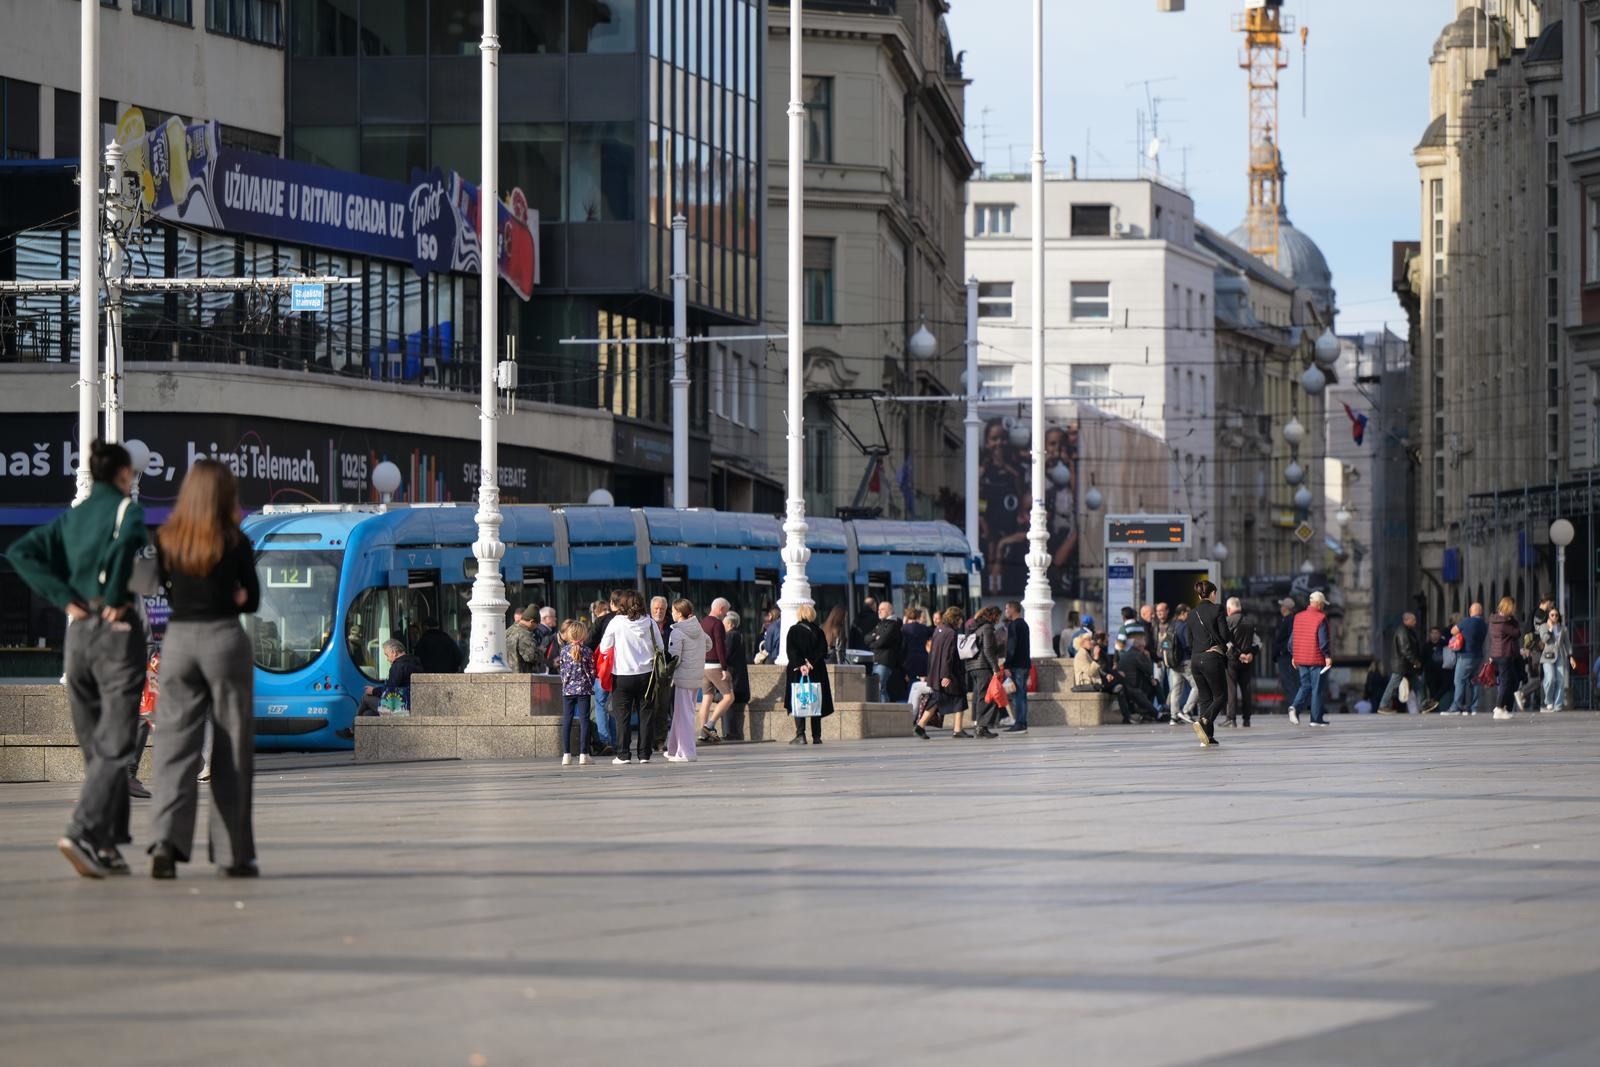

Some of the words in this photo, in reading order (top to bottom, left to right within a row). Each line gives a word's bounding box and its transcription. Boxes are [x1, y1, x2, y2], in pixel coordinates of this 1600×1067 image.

[224, 163, 285, 217] UŽIVANJE
[289, 183, 298, 219] U
[301, 185, 342, 228] RITMU
[345, 194, 387, 236] GRADA
[389, 202, 405, 239] UZ
[408, 179, 444, 236] Twist
[250, 445, 319, 484] Telemach.
[463, 463, 478, 484] SVE
[280, 568, 299, 584] 12
